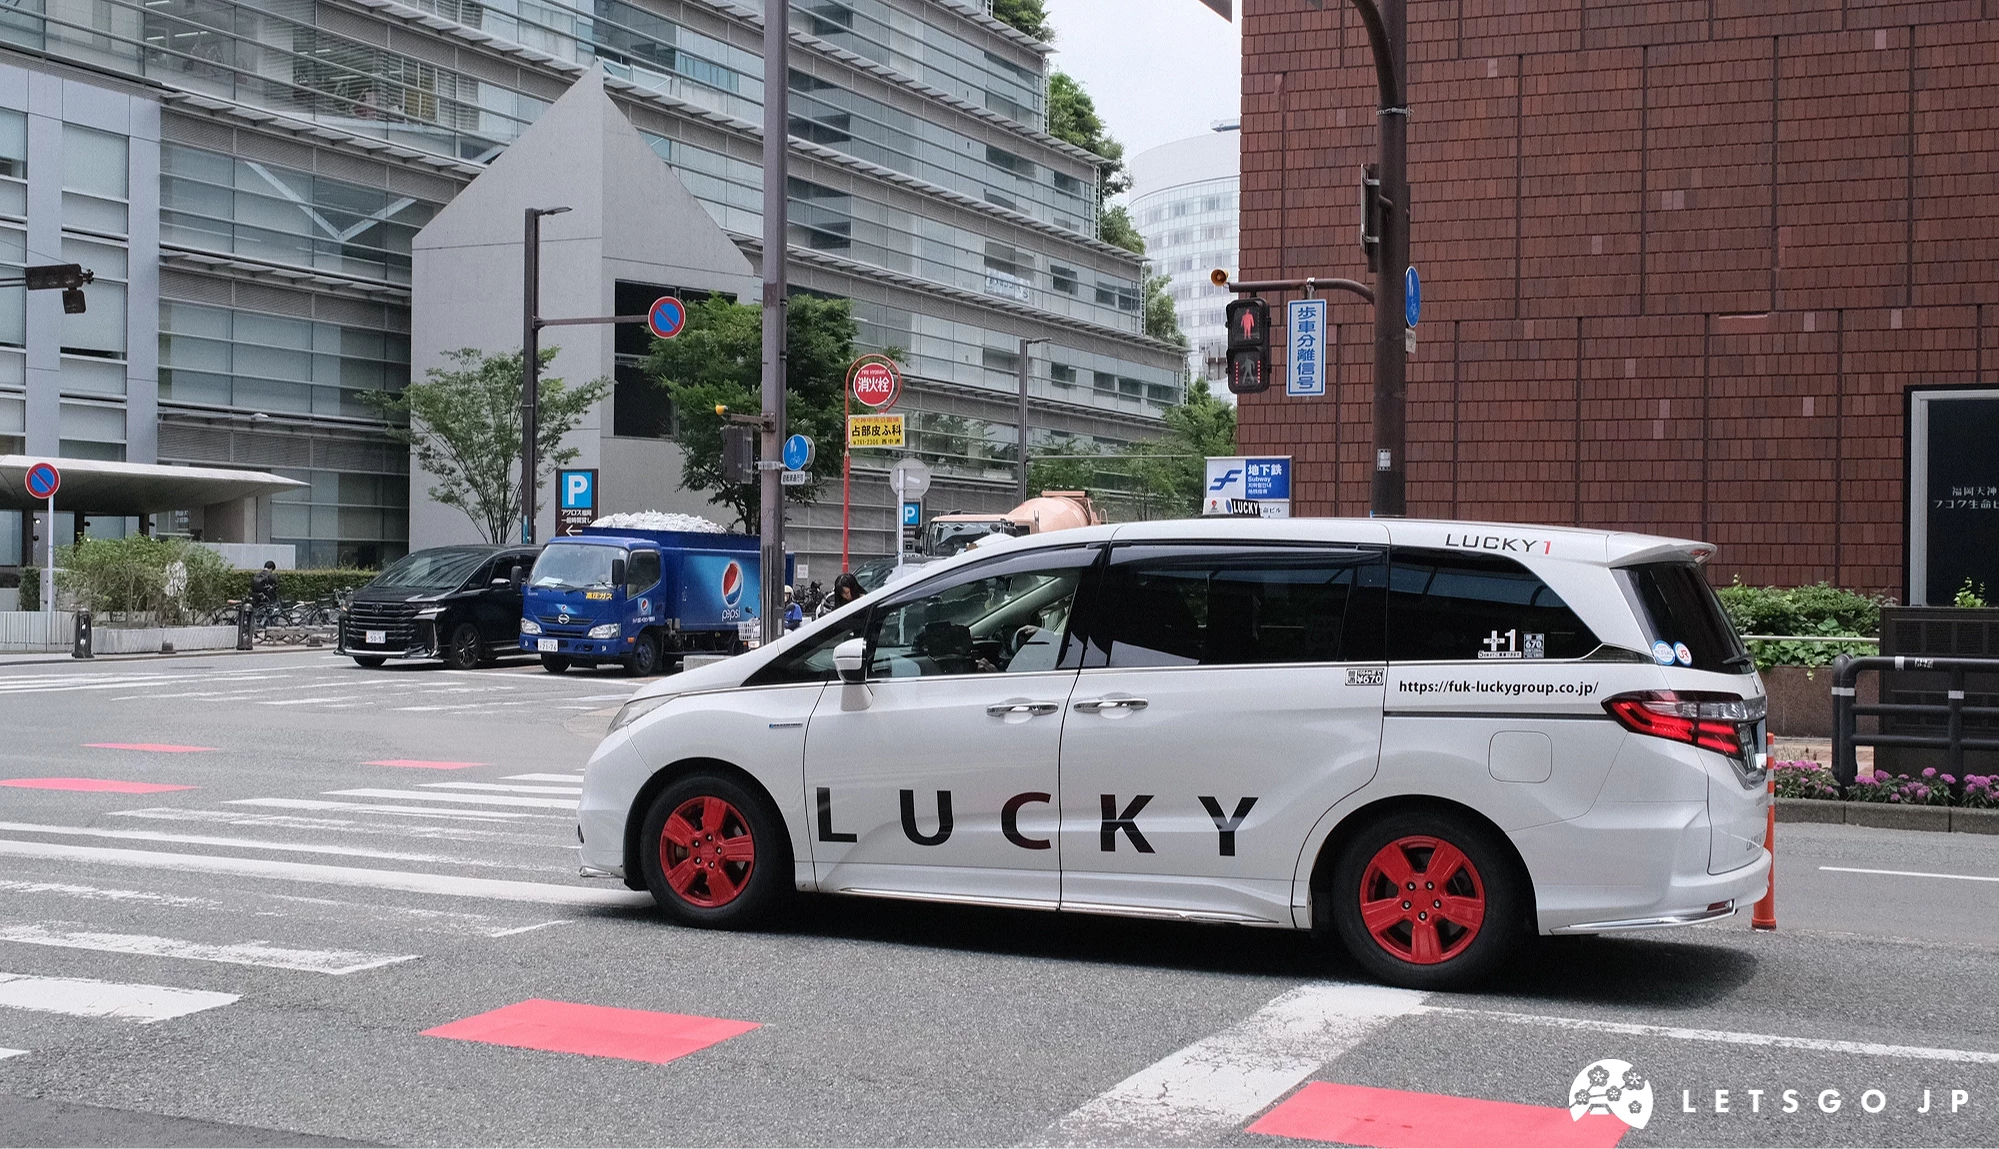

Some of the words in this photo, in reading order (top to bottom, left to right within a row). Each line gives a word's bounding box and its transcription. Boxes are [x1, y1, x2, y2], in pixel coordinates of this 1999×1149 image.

[1297, 306, 1316, 389] 歩車分離信号
[858, 376, 890, 392] 消火栓
[851, 424, 902, 436] 占部皮ふ科
[1248, 464, 1282, 476] 地下鉄
[568, 475, 588, 505] P
[1951, 486, 1997, 497] 福岡天神
[904, 507, 916, 522] P
[1233, 500, 1259, 515] LUCKY
[1445, 533, 1537, 553] LUCKY
[586, 592, 612, 600] 高圧ガス
[722, 607, 740, 621] pepsi
[1525, 640, 1542, 648] 670
[1679, 649, 1689, 659] JR
[1357, 675, 1382, 684] ¥670
[1399, 680, 1599, 696] https://fuk-luckygroup.co.jp/
[816, 787, 1260, 857] LUCKY
